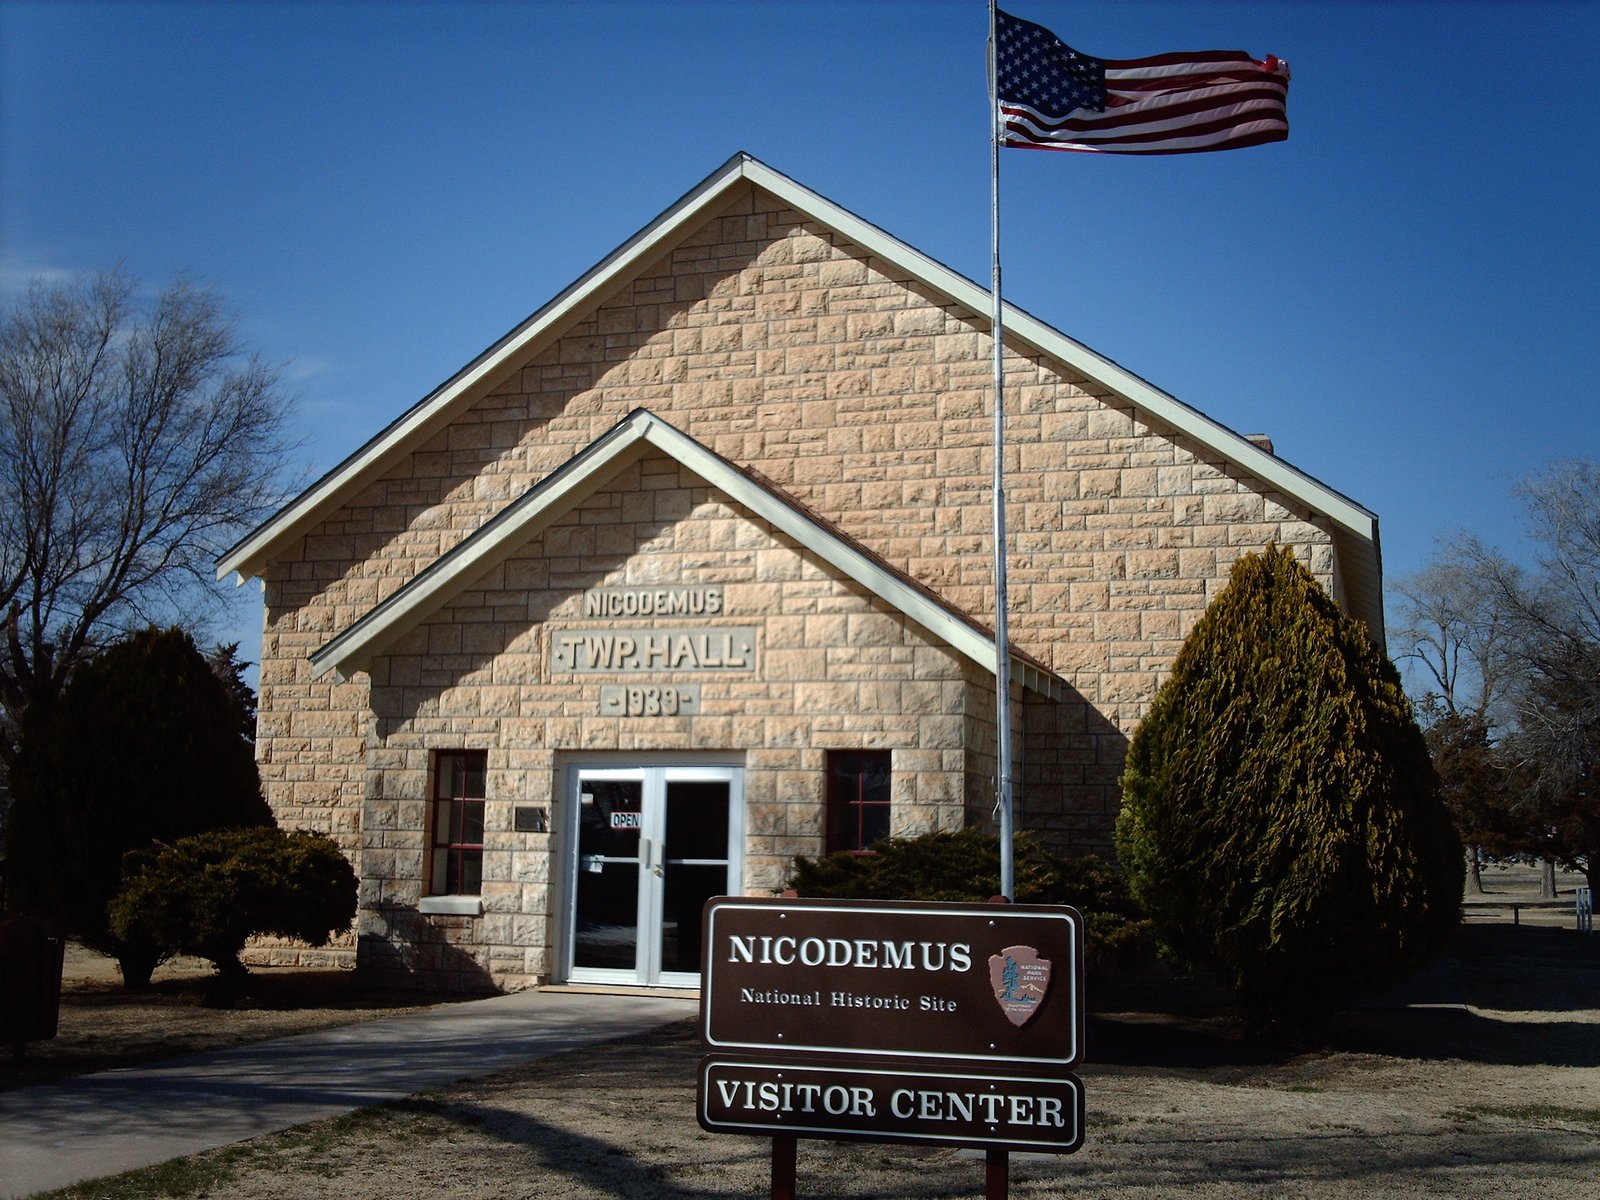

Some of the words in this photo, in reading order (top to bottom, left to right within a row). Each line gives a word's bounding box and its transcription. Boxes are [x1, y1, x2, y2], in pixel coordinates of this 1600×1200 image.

[585, 589, 722, 617] NICODEMUS
[613, 813, 640, 827] OPEN
[728, 935, 972, 972] NICODEMUS
[740, 987, 821, 1006] National
[831, 992, 910, 1011] Historic
[919, 996, 957, 1013] Site
[716, 1079, 877, 1118] VISITOR
[890, 1089, 1066, 1129] CENTER
